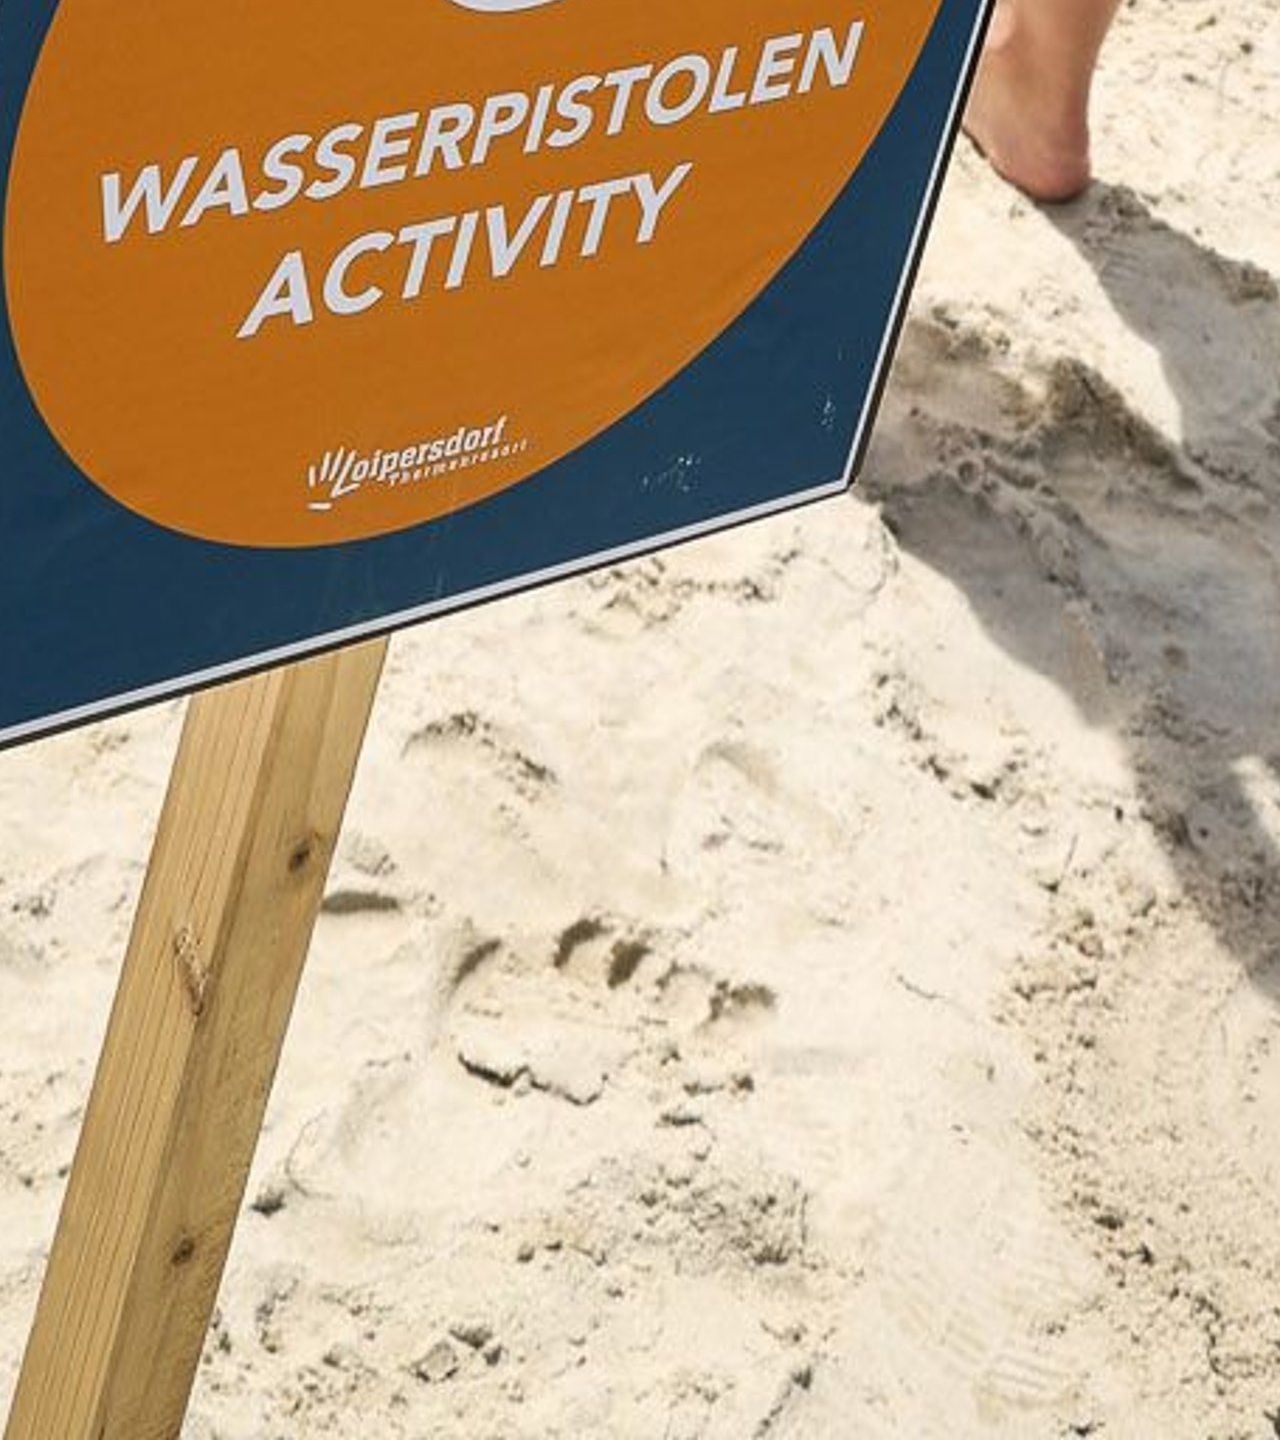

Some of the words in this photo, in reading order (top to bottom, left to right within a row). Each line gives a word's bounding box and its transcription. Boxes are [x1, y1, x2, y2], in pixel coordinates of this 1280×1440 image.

[99, 20, 865, 244] WASSERPISTOLEN
[235, 163, 694, 339] ACTIVITY
[330, 414, 508, 499] Loipersdorf
